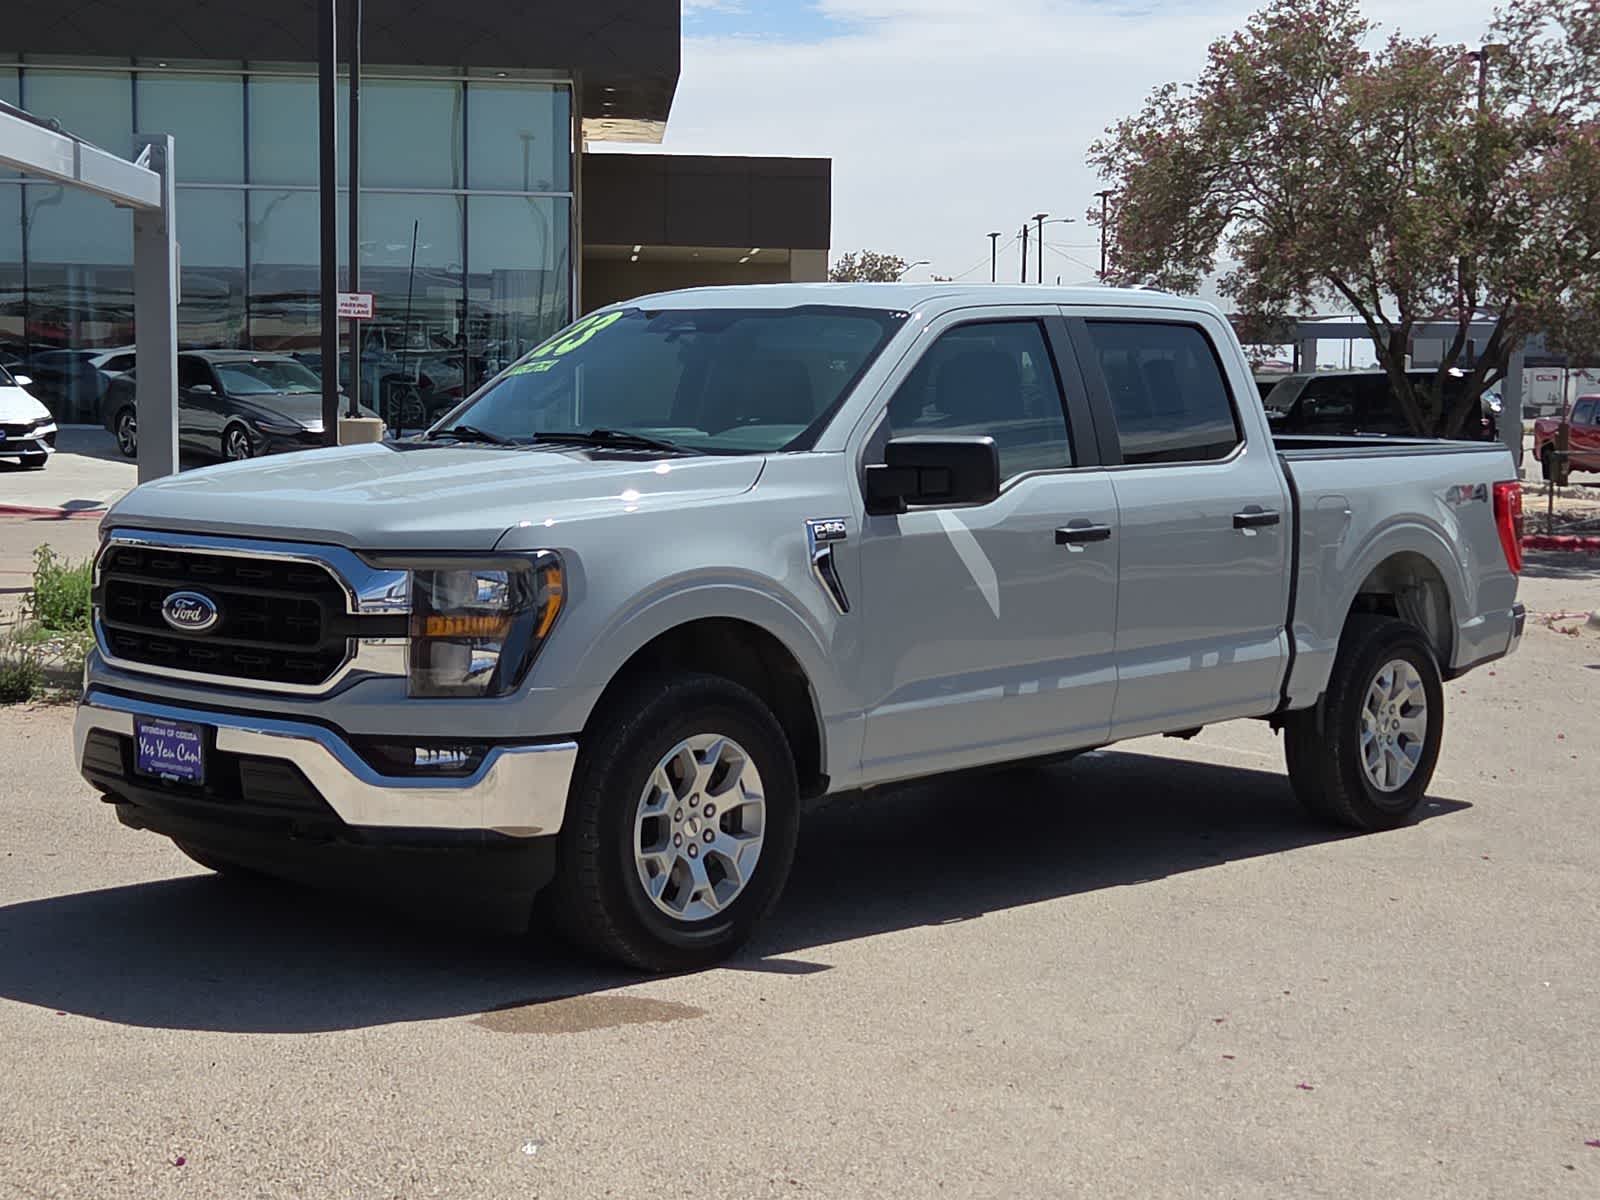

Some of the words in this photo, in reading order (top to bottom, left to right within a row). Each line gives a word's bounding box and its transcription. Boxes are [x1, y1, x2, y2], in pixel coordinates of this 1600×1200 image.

[171, 598, 203, 621] Ford
[139, 736, 155, 758] Yes
[155, 738, 175, 758] You
[176, 743, 202, 766] Can!
